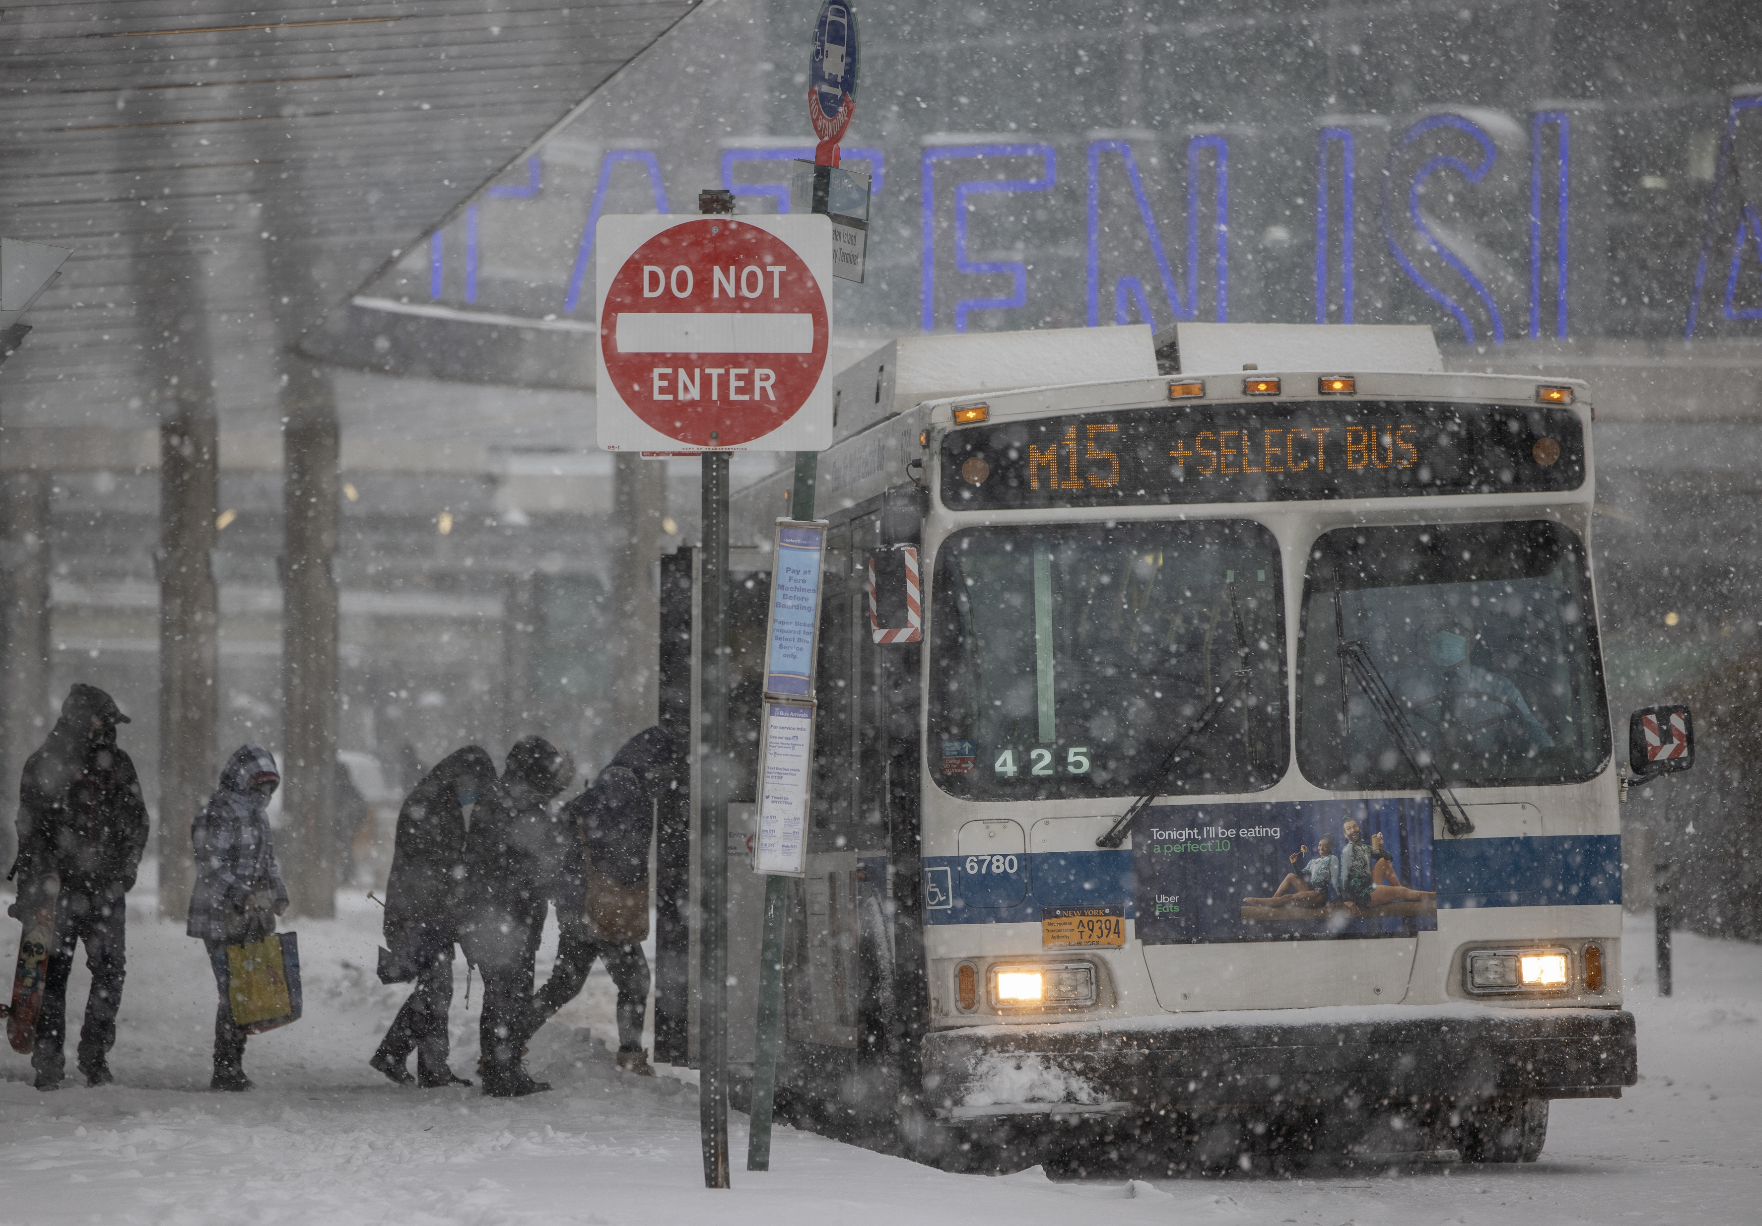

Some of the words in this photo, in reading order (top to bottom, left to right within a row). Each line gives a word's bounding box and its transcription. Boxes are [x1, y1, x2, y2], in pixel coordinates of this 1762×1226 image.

[810, 94, 819, 119] NO
[817, 102, 848, 138] STANDING
[643, 265, 694, 299] DO
[713, 265, 787, 299] NOT
[652, 367, 777, 401] ENTER
[1029, 424, 1119, 491] M15
[1168, 427, 1329, 475] +SELECT
[1346, 423, 1418, 470] BUS
[786, 567, 801, 575] Pay
[788, 576, 807, 584] Fare
[777, 584, 817, 594] Machines
[782, 594, 810, 602] Before
[775, 602, 815, 612] Boarding.
[773, 618, 793, 626] Paper
[794, 620, 814, 628] ticket
[774, 635, 796, 643] Select
[778, 644, 804, 652] Service
[1151, 827, 1202, 841] Tonight,
[1219, 826, 1236, 838] be
[1239, 826, 1280, 840] eating
[1153, 844, 1161, 854] a
[1164, 840, 1212, 856] perfect
[1215, 840, 1231, 852] 10
[965, 855, 1018, 875] 6780
[1155, 894, 1180, 904] Uber
[1155, 903, 1180, 913] Eats
